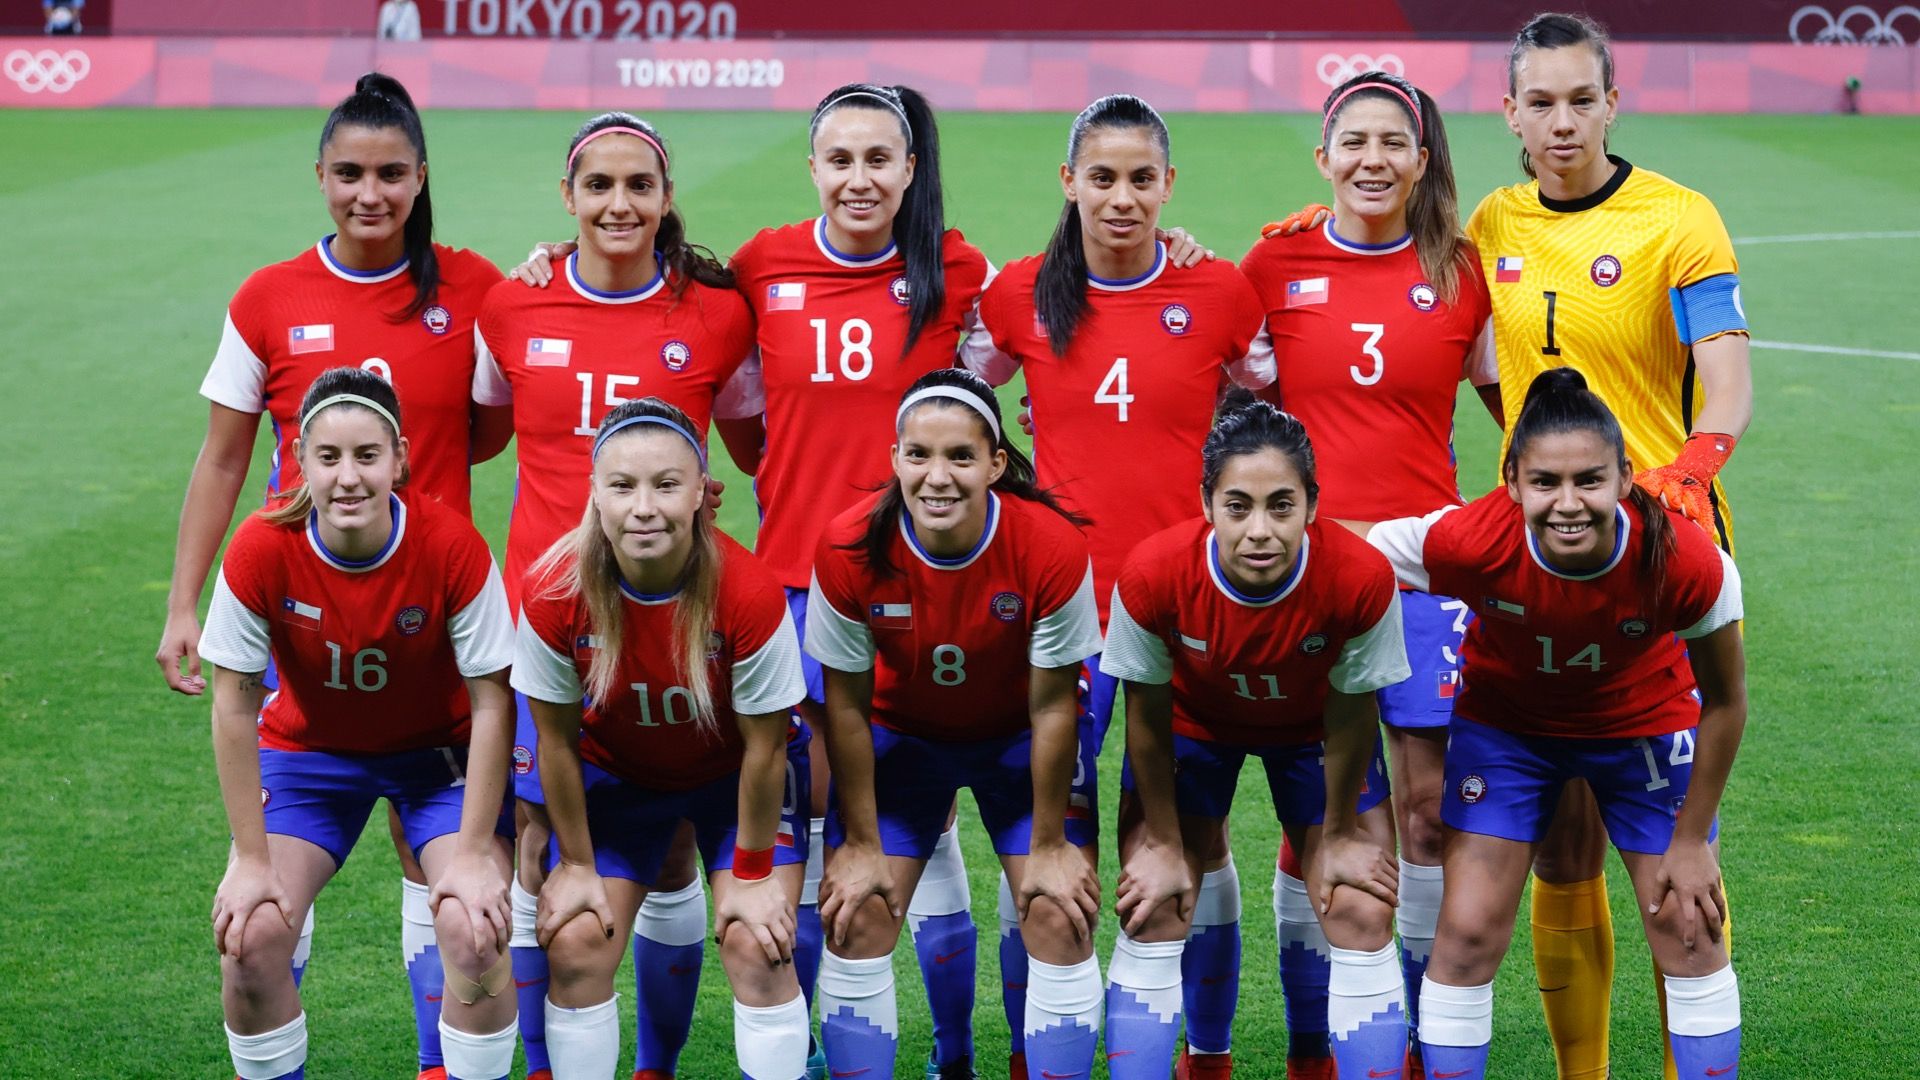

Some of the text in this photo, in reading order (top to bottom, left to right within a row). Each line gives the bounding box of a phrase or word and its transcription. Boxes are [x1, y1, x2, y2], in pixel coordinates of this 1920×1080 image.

[441, 0, 737, 42] TOKYO 2020
[616, 58, 785, 87] TOKYO 2020
[809, 317, 874, 382] 18
[1541, 291, 1561, 356] 1
[1349, 322, 1385, 386] 3
[1094, 357, 1135, 422] 4
[1440, 599, 1469, 665] 3
[1535, 635, 1608, 674] 14
[324, 640, 388, 692] 16
[932, 643, 967, 687] 8
[1229, 673, 1288, 700] 11
[630, 683, 698, 727] 10
[1632, 728, 1695, 792] 14
